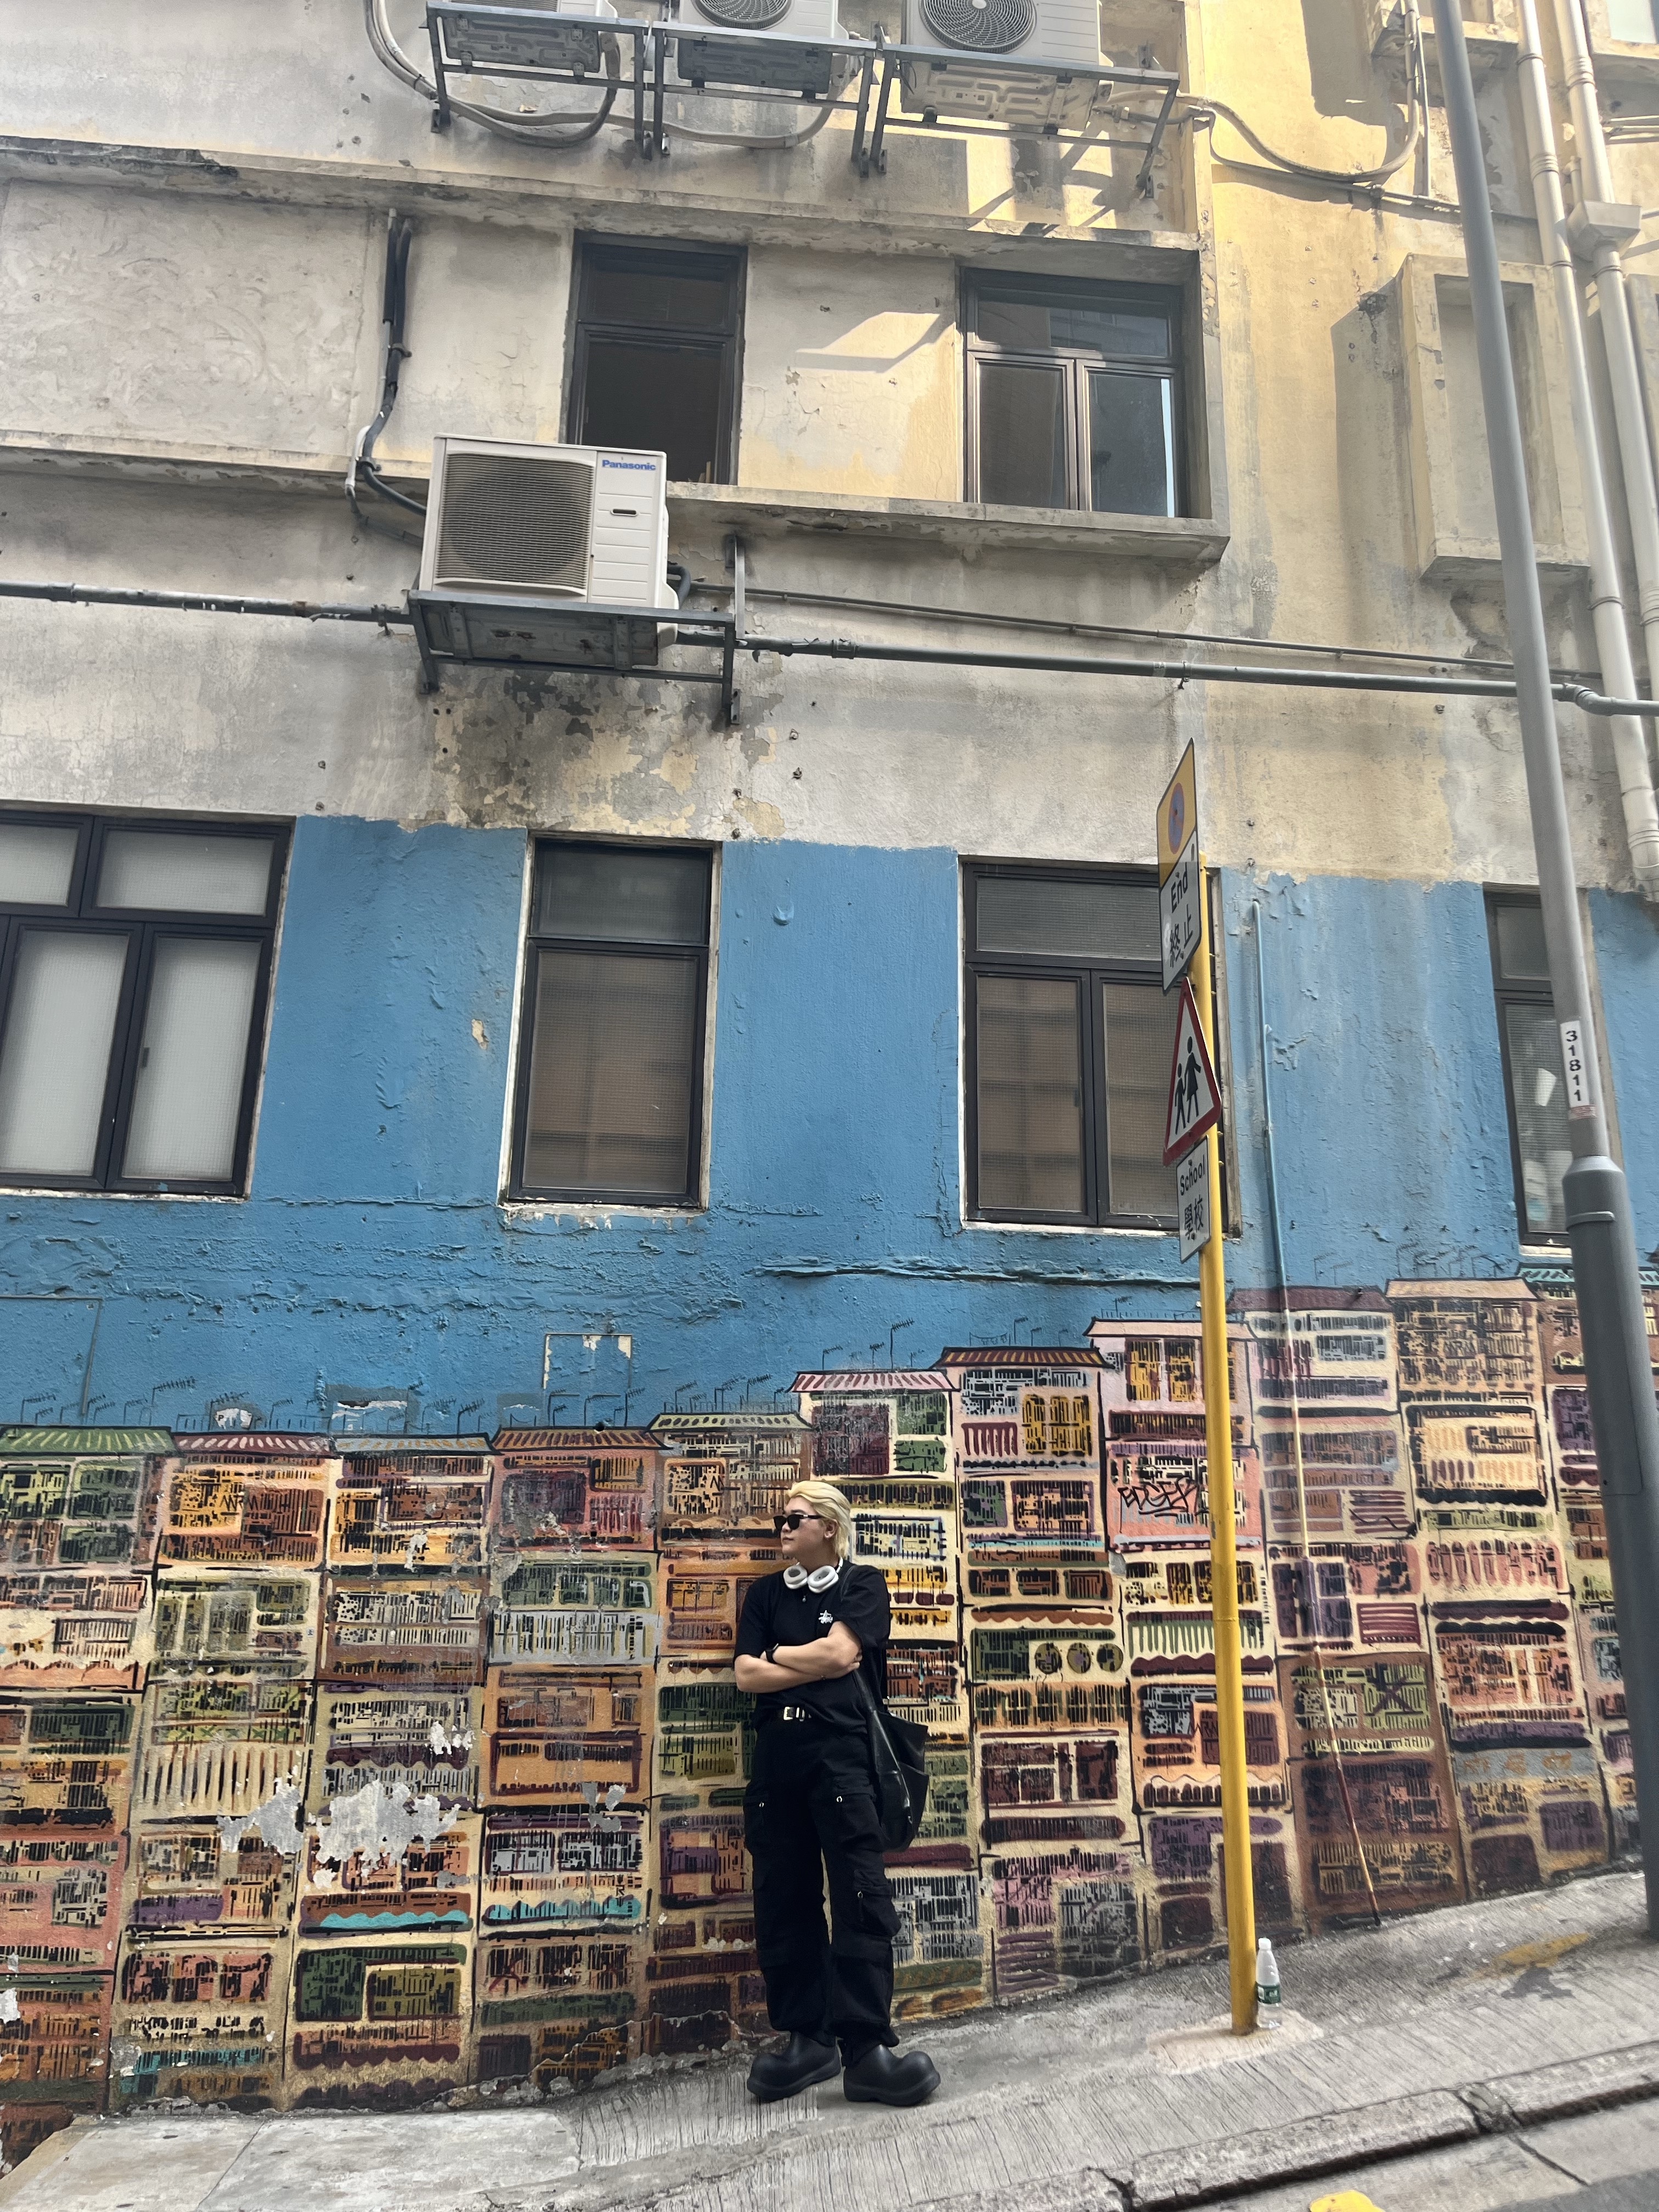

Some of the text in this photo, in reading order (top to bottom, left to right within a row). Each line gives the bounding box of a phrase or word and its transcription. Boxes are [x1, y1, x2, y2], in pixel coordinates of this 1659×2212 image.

[602, 460, 656, 471] Panasonic
[1170, 861, 1188, 913] End
[1170, 903, 1193, 968] 終止
[1565, 1030, 1582, 1101] 31811
[1180, 1154, 1205, 1196] School
[1184, 1194, 1204, 1241] 學校
